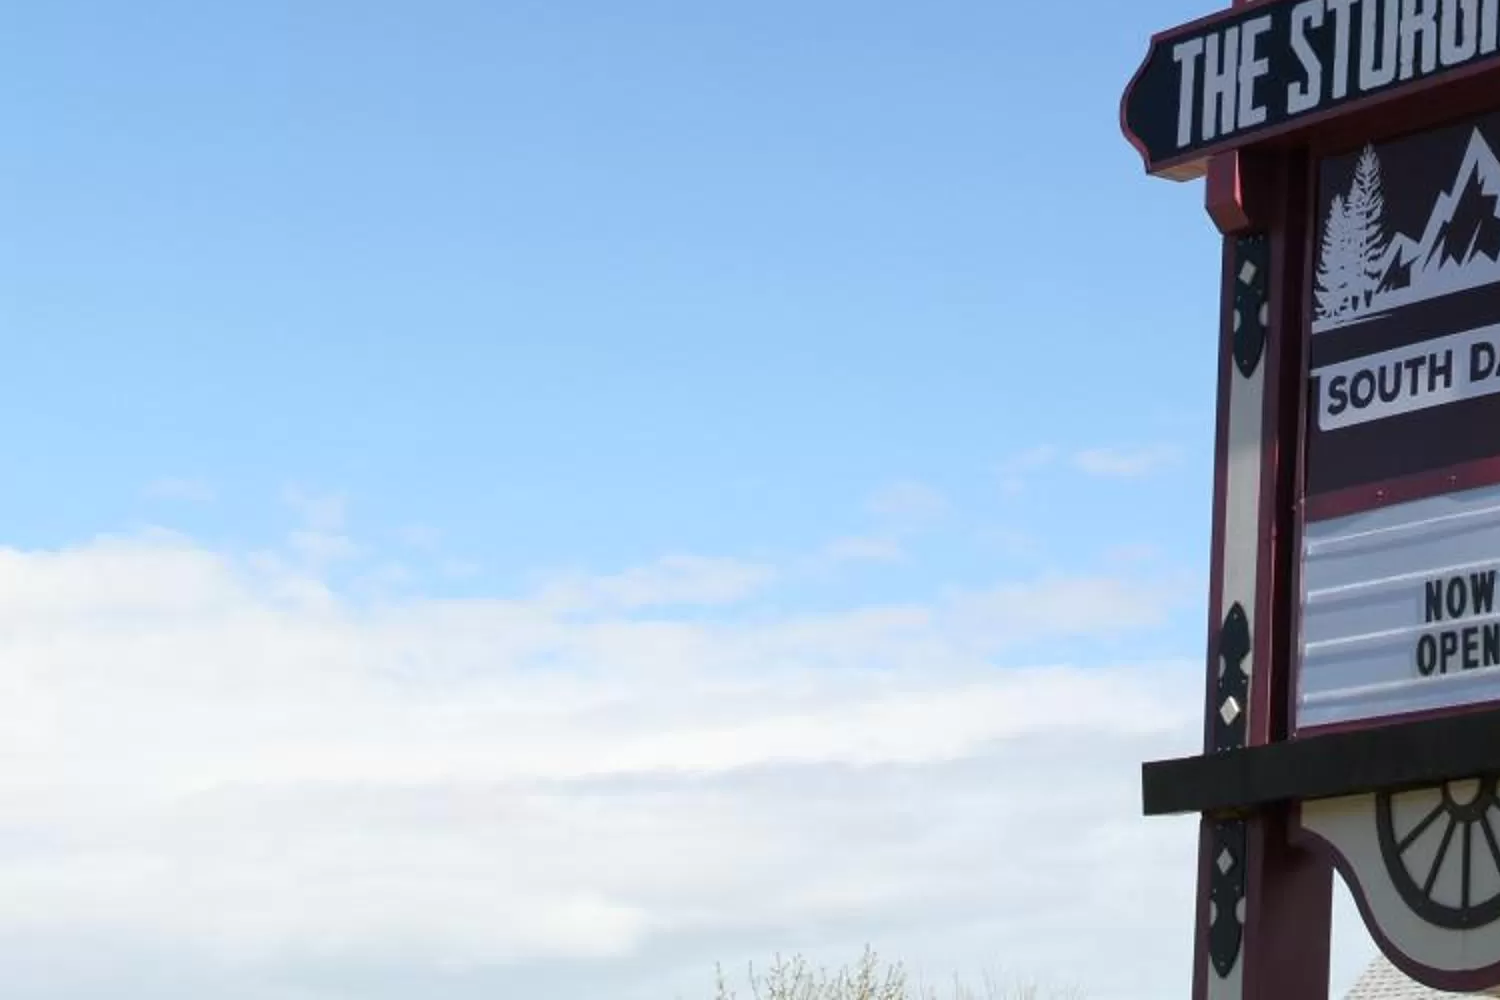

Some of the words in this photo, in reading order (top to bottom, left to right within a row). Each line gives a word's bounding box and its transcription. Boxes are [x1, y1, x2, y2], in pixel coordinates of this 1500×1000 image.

[1174, 15, 1271, 147] THE
[1327, 349, 1452, 416] SOUTH
[1425, 570, 1496, 622] NOW
[1417, 623, 1500, 676] OPEN
